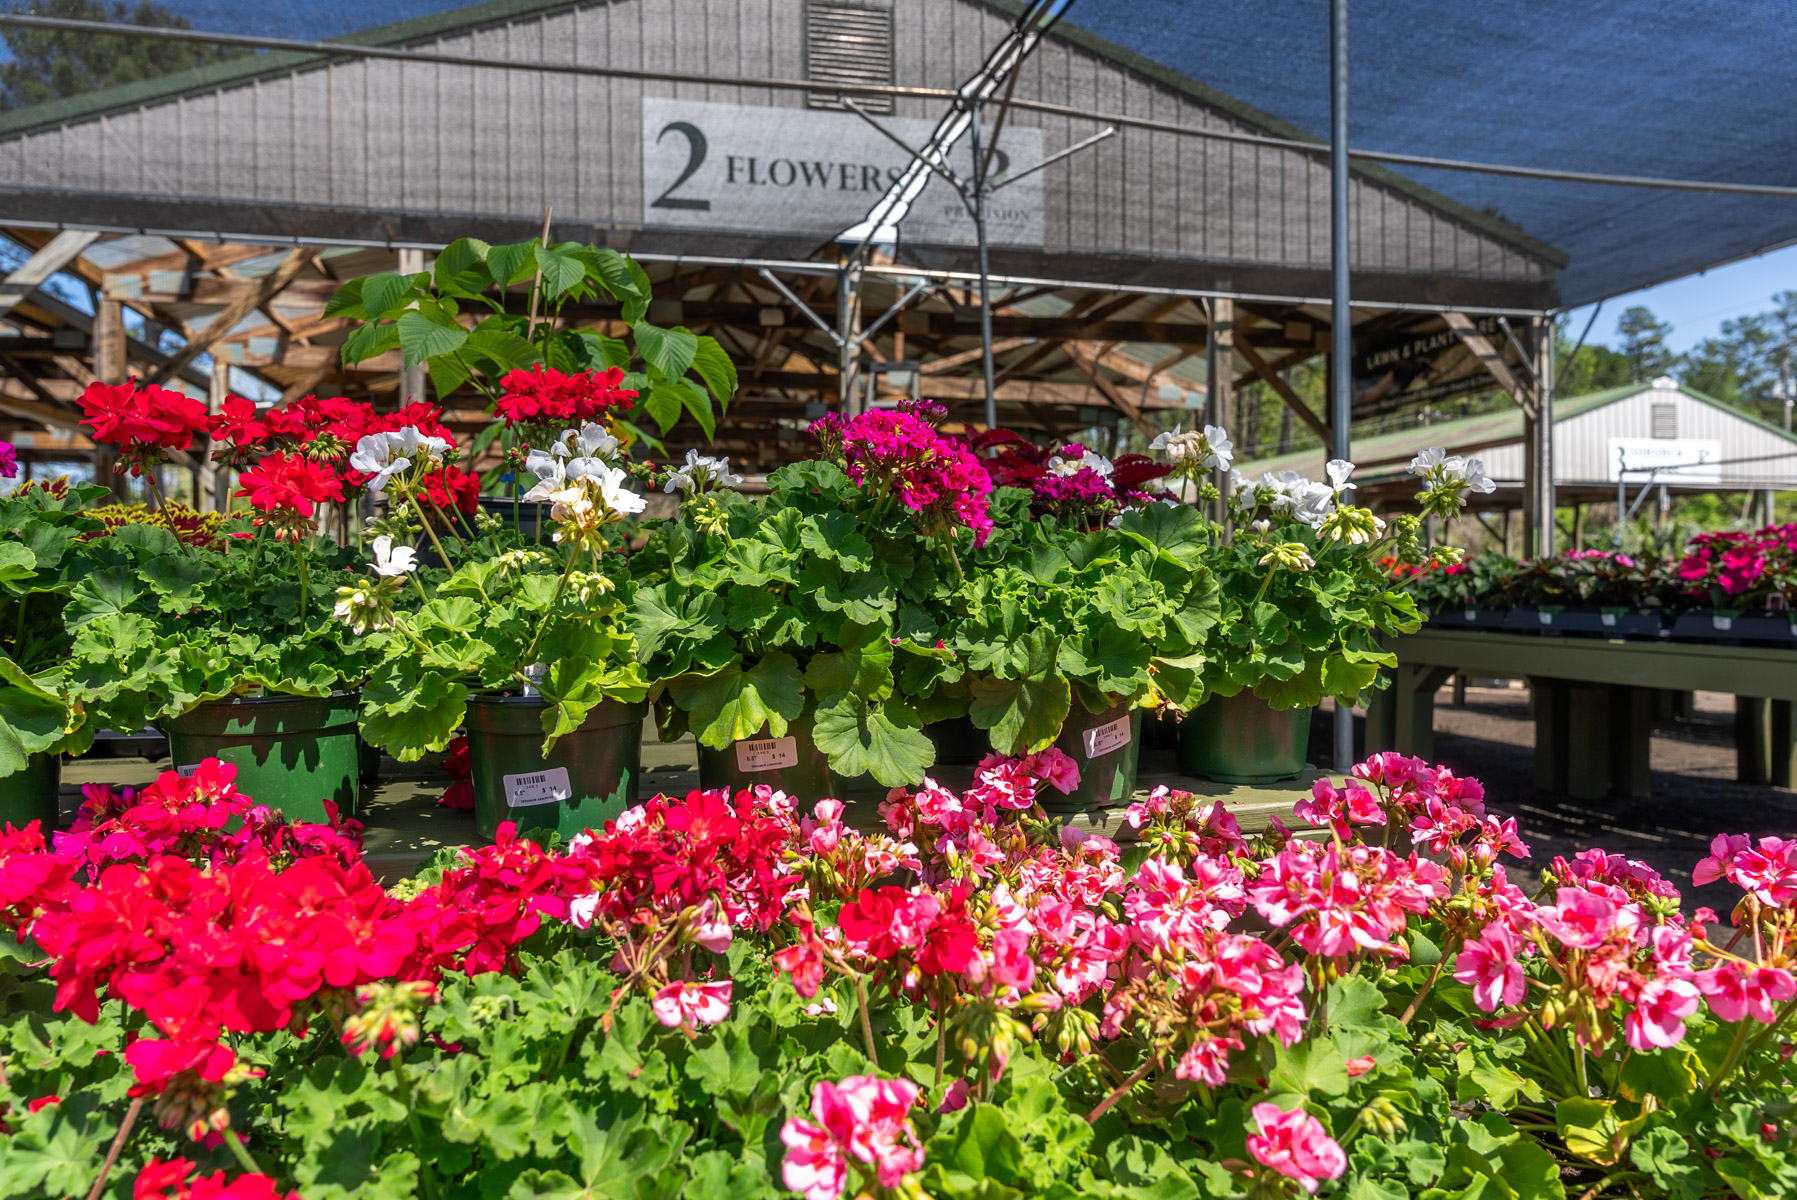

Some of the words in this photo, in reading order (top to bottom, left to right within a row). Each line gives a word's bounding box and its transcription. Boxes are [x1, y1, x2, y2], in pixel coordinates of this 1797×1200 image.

[651, 121, 711, 211] 2
[726, 155, 903, 192] FLOWERS
[944, 205, 1030, 220] PRISION
[1366, 348, 1400, 370] LAWN
[1402, 344, 1411, 359] &
[1414, 330, 1456, 355] PLANT
